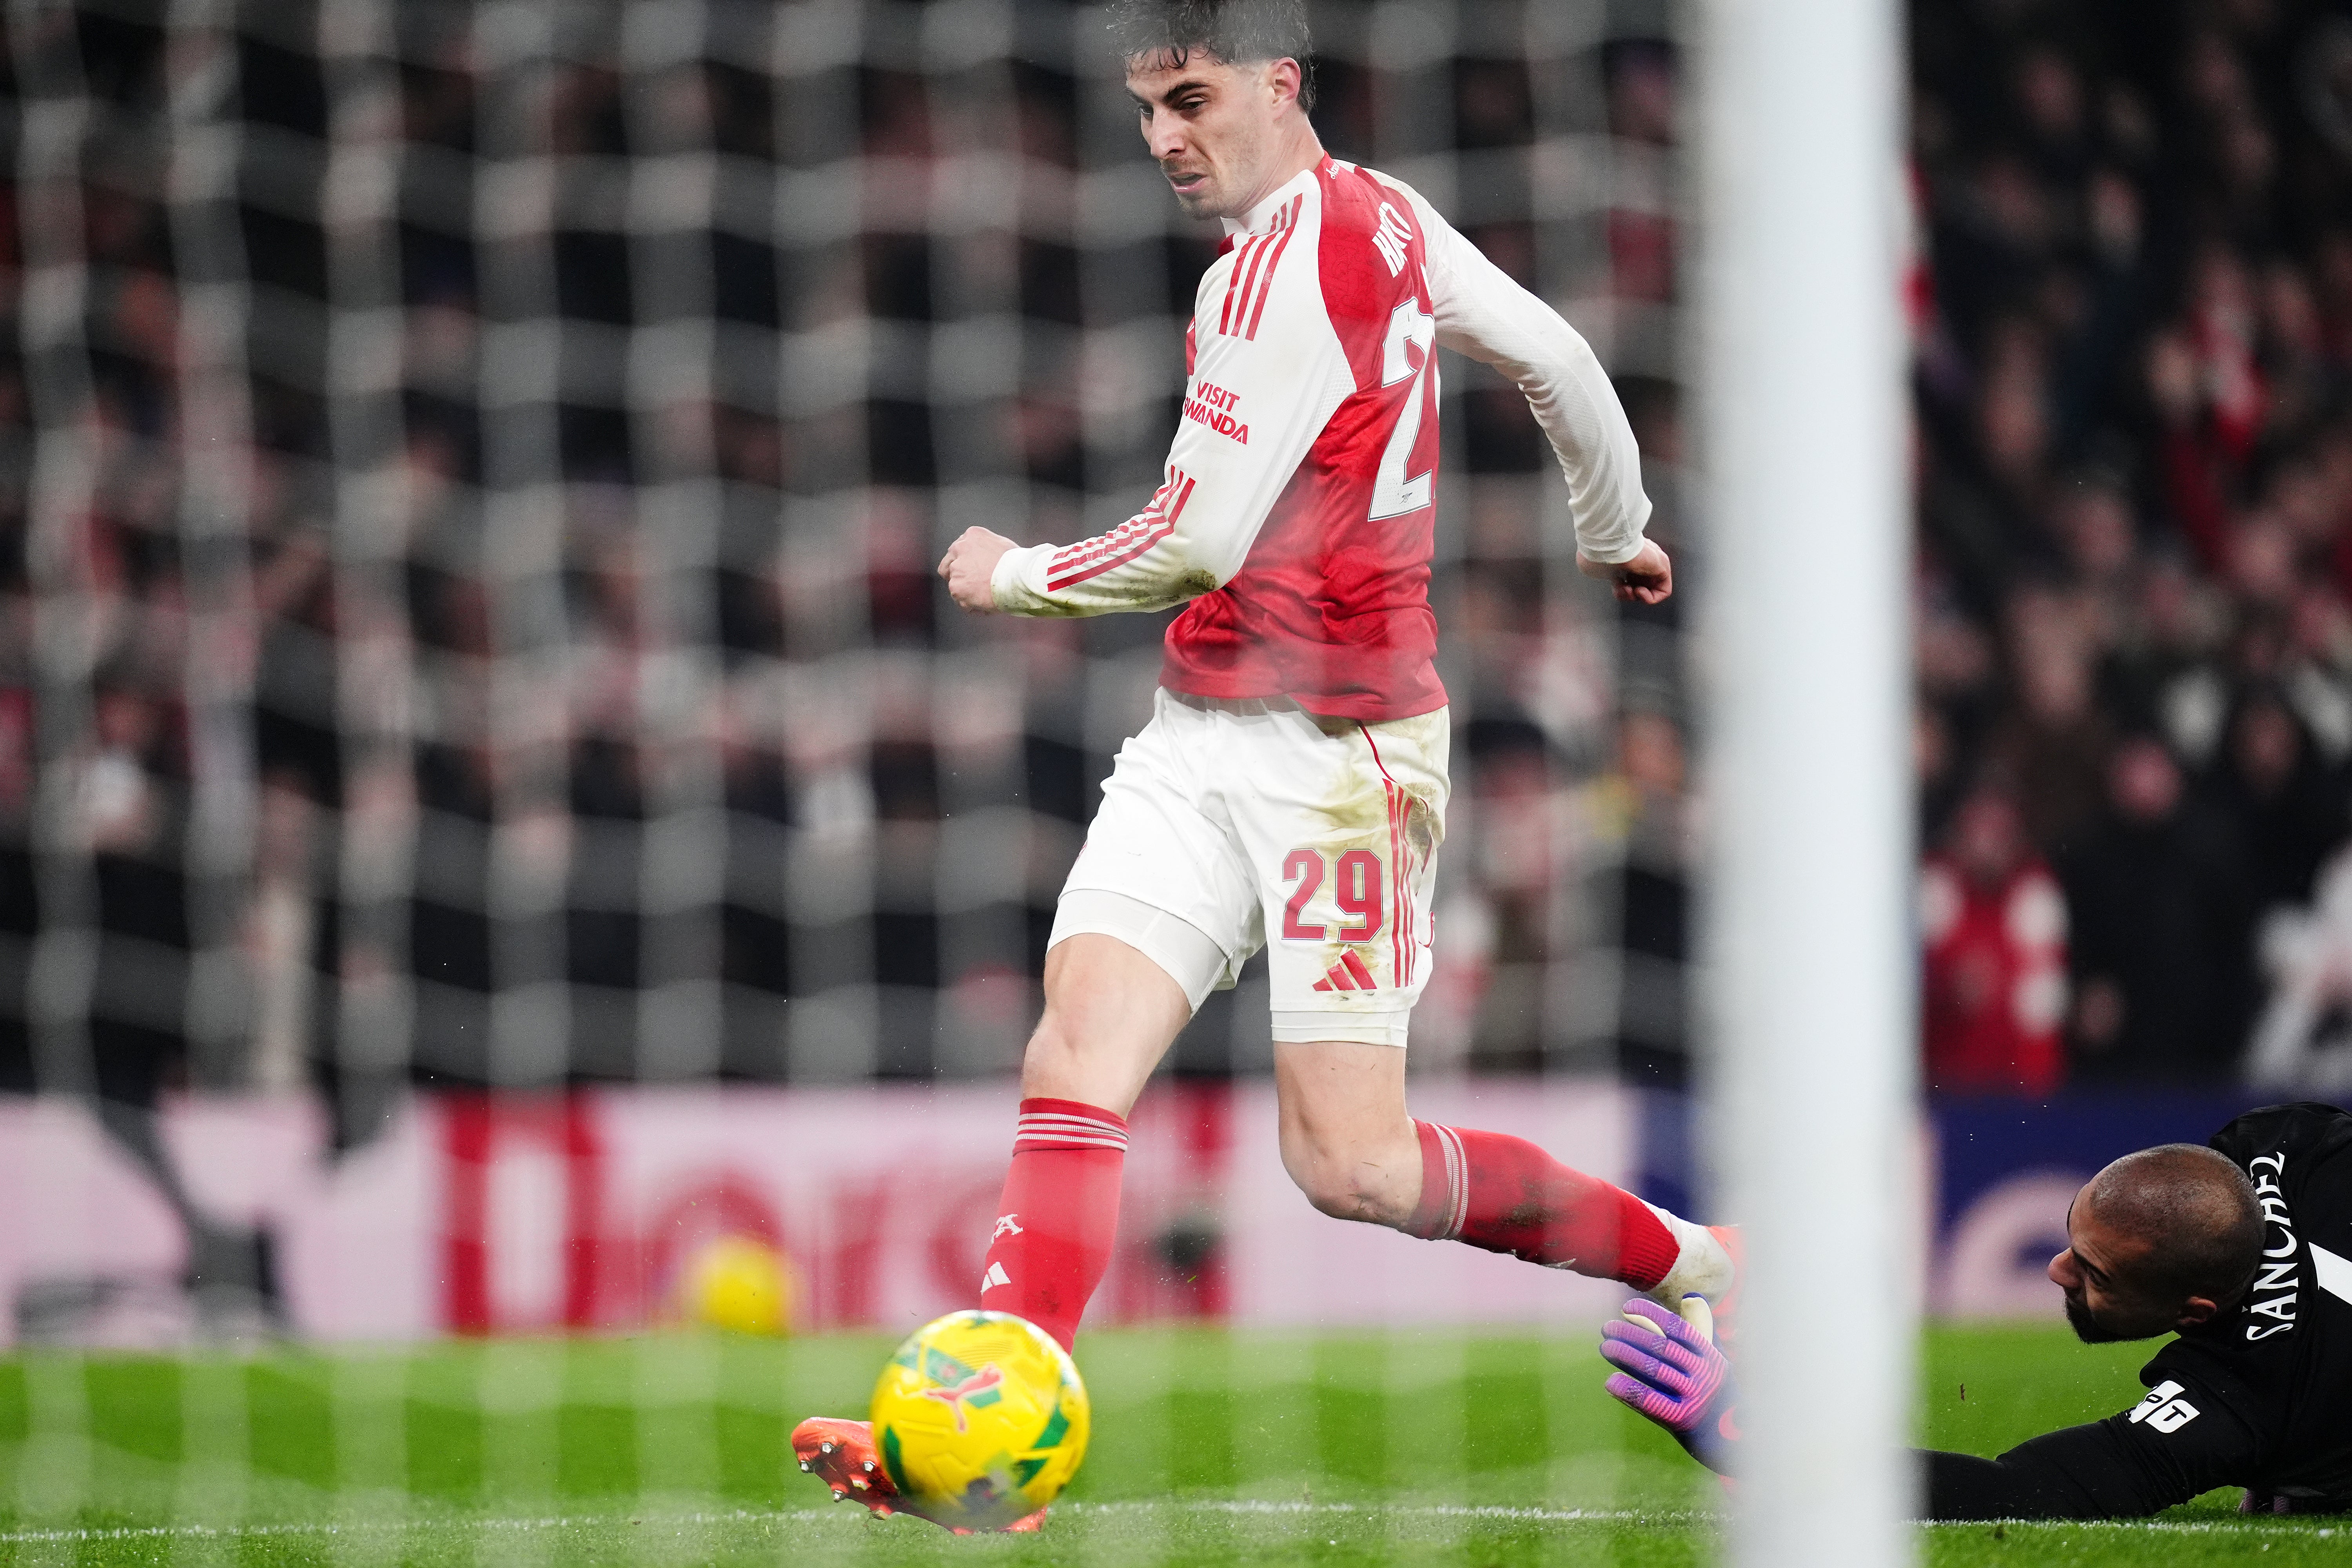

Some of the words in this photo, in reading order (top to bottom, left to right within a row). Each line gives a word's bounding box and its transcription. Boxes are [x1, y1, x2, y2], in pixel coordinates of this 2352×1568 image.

[1183, 396, 1249, 445] RWANDA
[1198, 379, 1240, 412] VISIT
[1368, 296, 1440, 521] 2
[1281, 848, 1384, 943] 29
